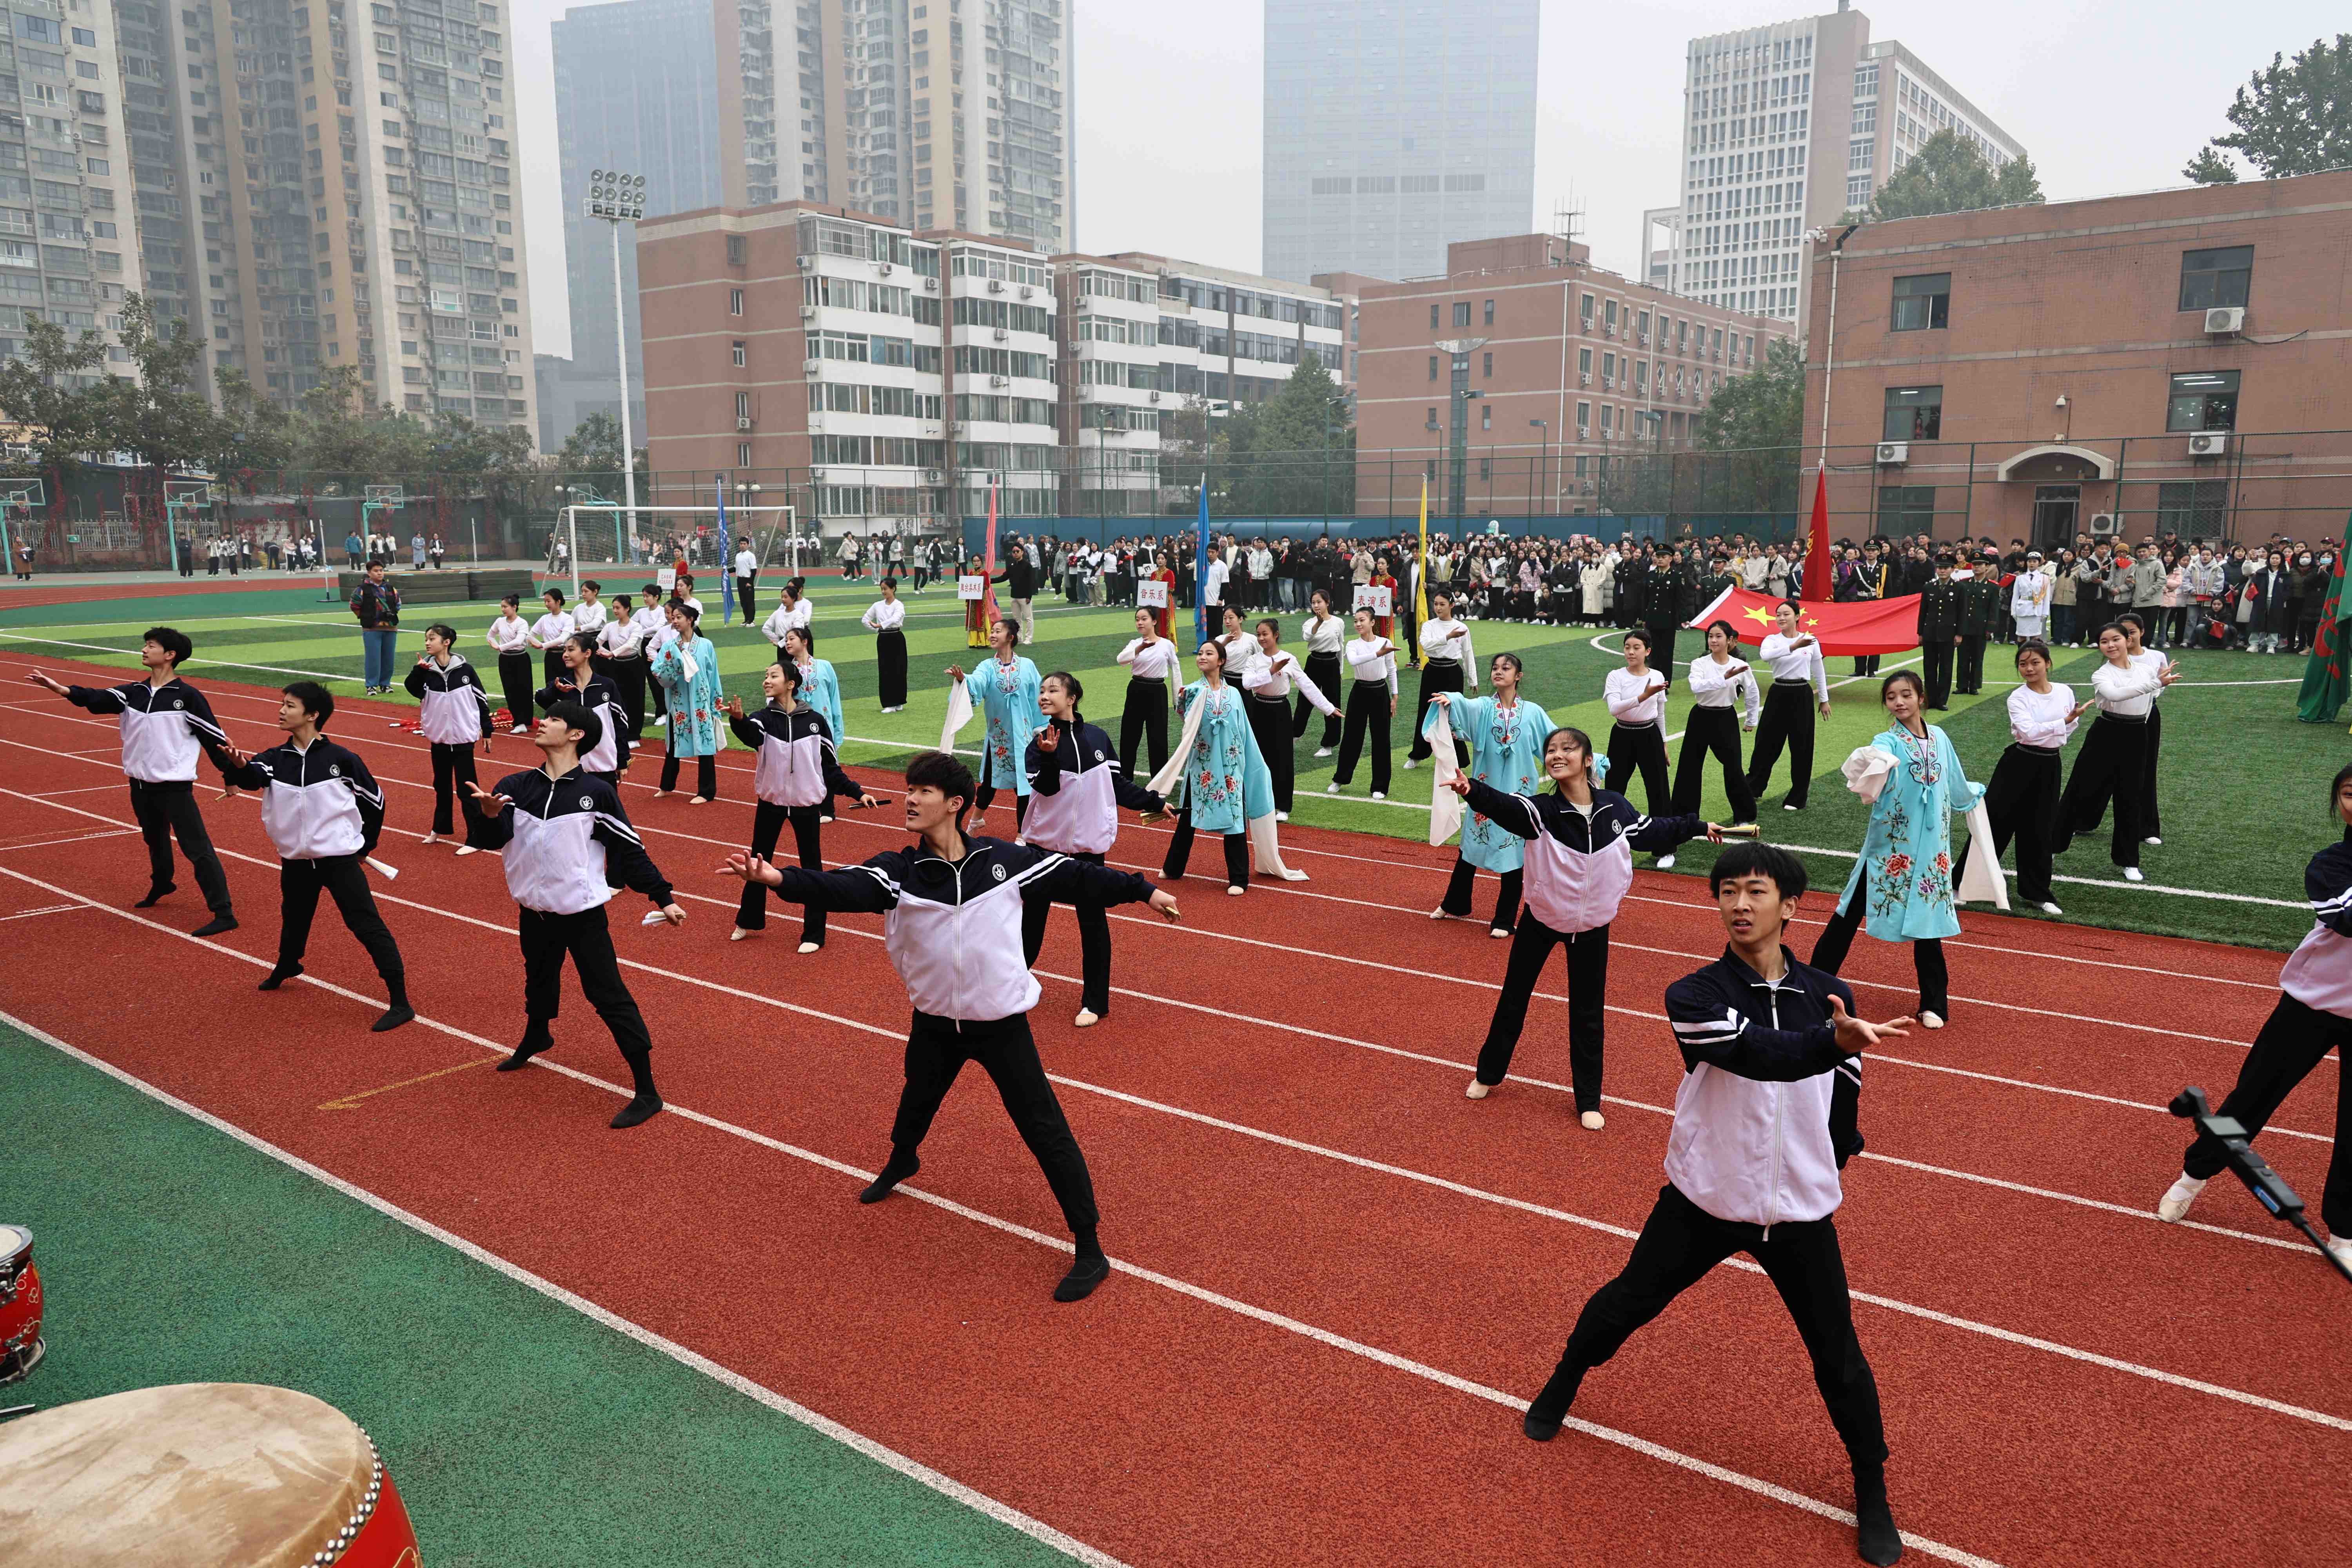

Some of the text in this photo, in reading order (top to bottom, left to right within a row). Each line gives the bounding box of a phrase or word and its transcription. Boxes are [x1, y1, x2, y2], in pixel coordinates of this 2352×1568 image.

[960, 583, 981, 592] 舞台美术系
[1141, 588, 1163, 600] 音乐系
[1357, 595, 1386, 607] 表演系
